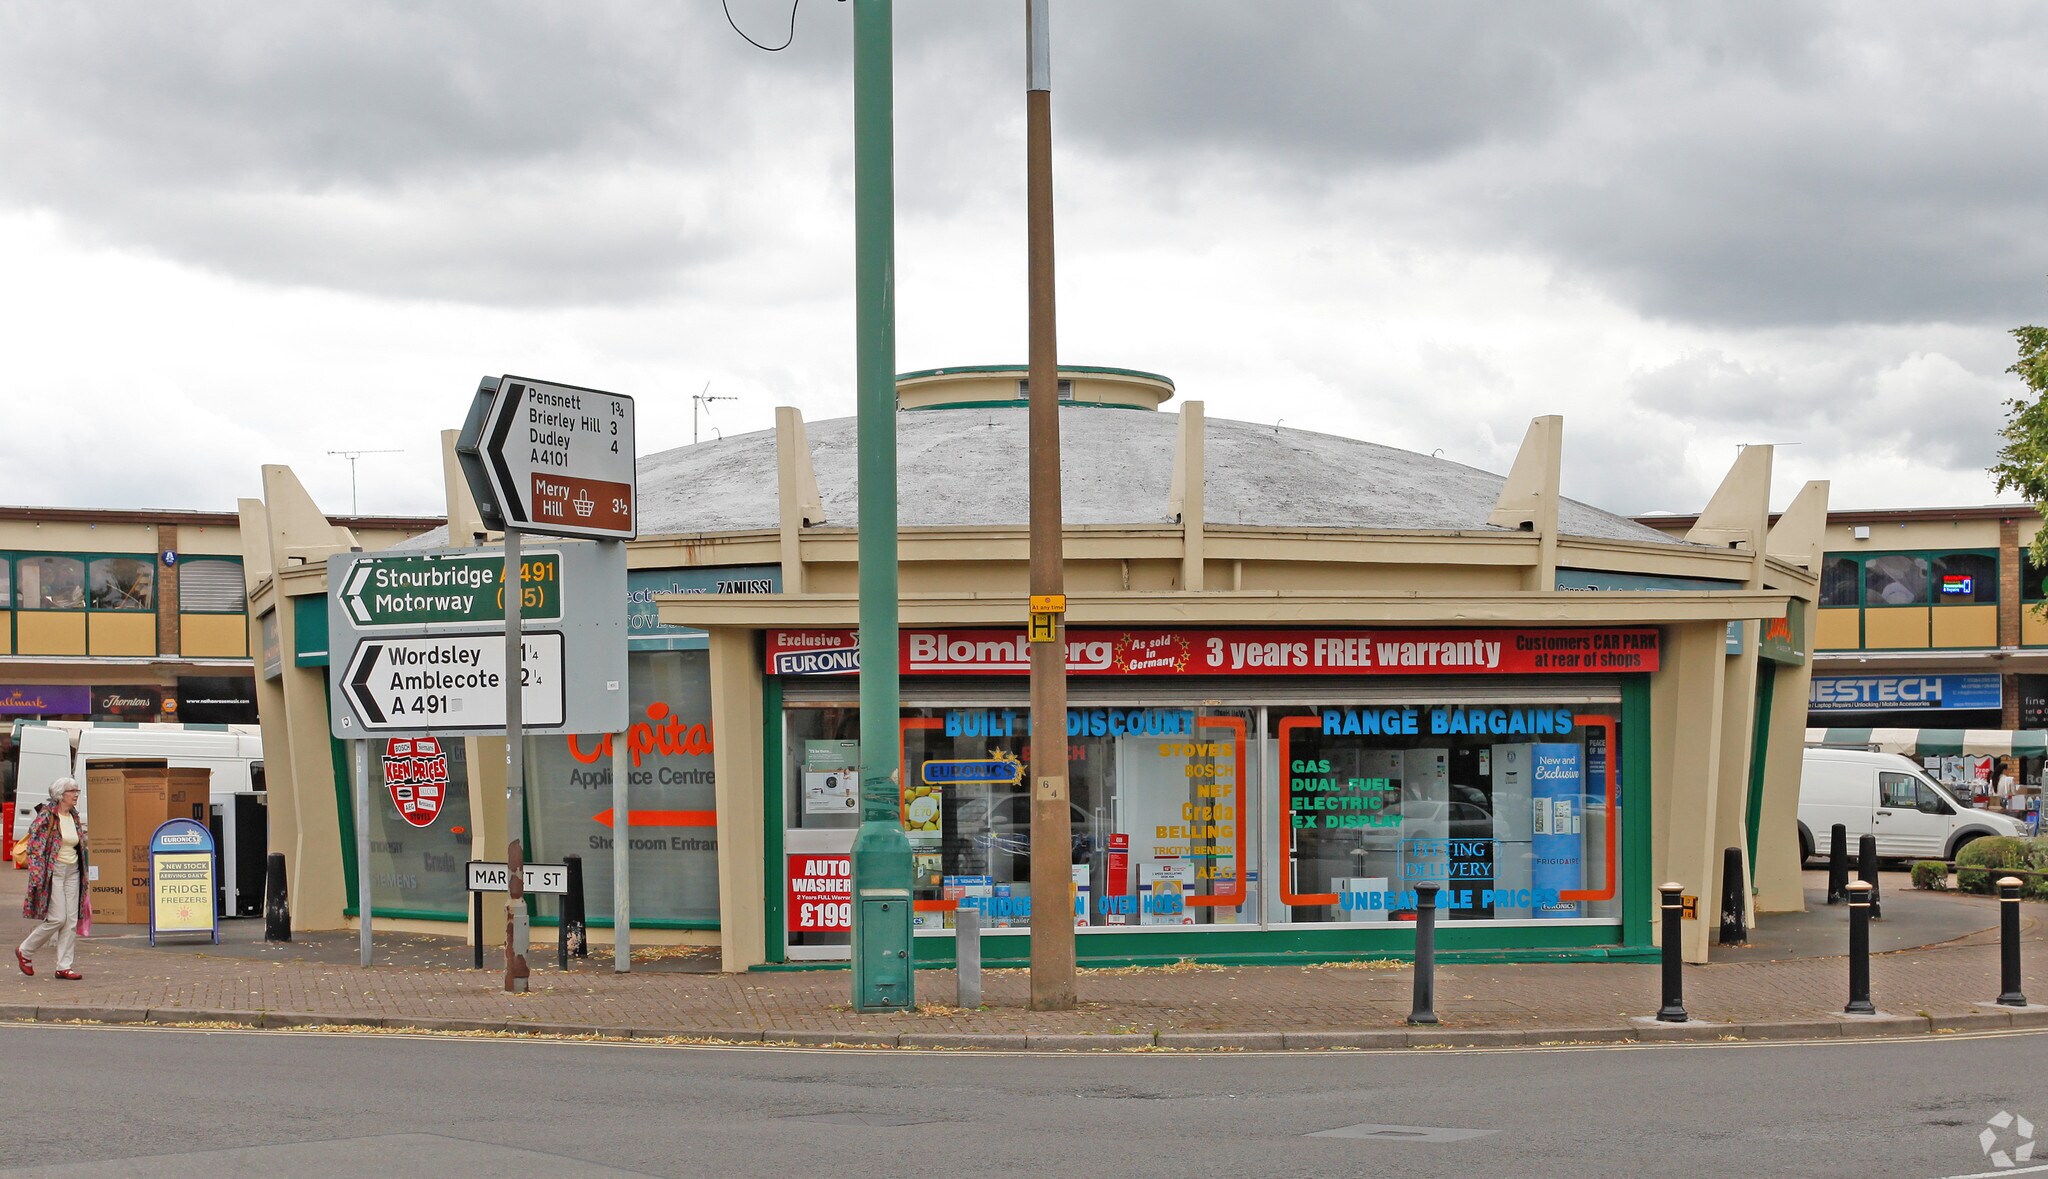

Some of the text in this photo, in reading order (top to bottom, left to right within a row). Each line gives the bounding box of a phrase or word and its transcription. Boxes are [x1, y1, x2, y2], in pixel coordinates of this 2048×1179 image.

[529, 388, 581, 410] Pensnett
[529, 408, 618, 435] Brierley Hill 3
[530, 428, 618, 454] Dudley 4
[536, 479, 570, 500] Merry
[543, 499, 564, 517] Hill
[375, 565, 493, 588] Stourbridge
[376, 585, 544, 614] Motorway (5)
[777, 633, 842, 646] Exclusive
[1132, 634, 1171, 650] As sold
[1516, 633, 1658, 652] Customers CAR PARK
[388, 646, 481, 667] Wordsley
[909, 634, 1113, 669] Blombrg
[1146, 648, 1156, 658] in
[1206, 637, 1501, 670] 3 years FREE warranty
[1129, 655, 1175, 671] Germany
[1534, 651, 1641, 670] at rear of shops
[390, 667, 499, 691] Amblecote
[102, 694, 150, 709] Thorntons
[945, 710, 1017, 737] BUILT
[1067, 710, 1195, 737] DISCOUNT
[1323, 709, 1573, 736] RANGE BARGAINS
[567, 702, 715, 767] Cpita
[394, 744, 411, 753] BOSCH
[1157, 743, 1233, 757] STOVES
[1291, 759, 1331, 774] GAS
[1539, 756, 1575, 765] New and
[384, 760, 411, 783] KEEN
[412, 757, 446, 782] PRICES
[658, 767, 716, 785] Centre
[930, 763, 1014, 779] EURONICS
[1185, 764, 1234, 778] BOSCH
[1042, 780, 1049, 789] 6
[1197, 784, 1233, 798] NEF
[1291, 777, 1395, 792] DUAL FUEL
[1051, 789, 1057, 798] 4
[1291, 796, 1382, 810] ELECTRIC
[1182, 802, 1233, 821] Creda
[1291, 814, 1404, 829] EX DISPLAY
[163, 836, 197, 844] EURONICS
[1155, 825, 1233, 839] BELLING
[589, 836, 718, 850] Shoroom Entran
[1153, 846, 1232, 855] TRICITY BENDIX
[1412, 842, 1486, 857] FITTING
[804, 859, 850, 876] AUTO
[1195, 866, 1233, 879] AEG
[1406, 861, 1493, 877] DELIVERY
[475, 870, 561, 886] MART ST
[792, 878, 851, 892] WASHER
[92, 886, 123, 894] Hisense
[161, 884, 207, 894] FRIDGE
[161, 896, 207, 904] FREEZERS
[1098, 895, 1138, 915] OVEN
[1143, 894, 1183, 914] HOBS
[1481, 889, 1559, 909] PRICES
[800, 902, 852, 927] £199
